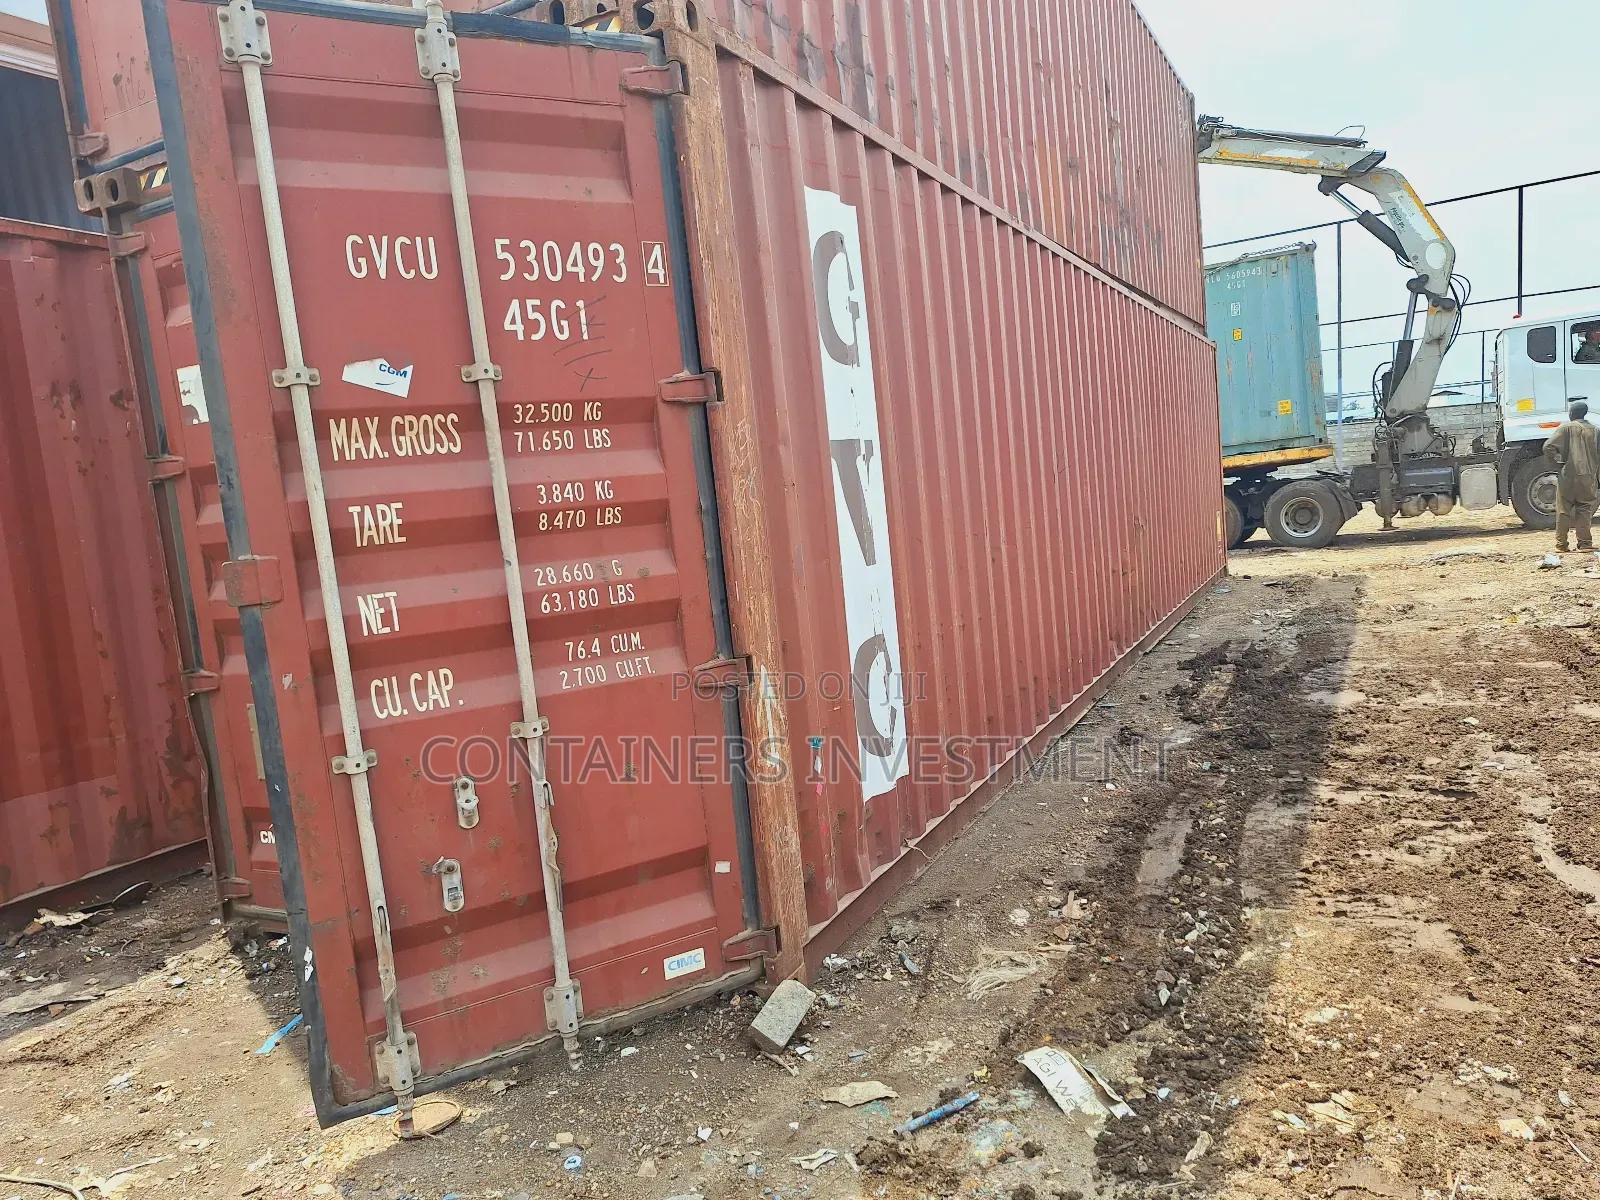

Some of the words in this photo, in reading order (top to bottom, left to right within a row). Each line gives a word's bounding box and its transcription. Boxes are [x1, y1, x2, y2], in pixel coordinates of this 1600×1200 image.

[346, 234, 439, 280] GVCU
[494, 238, 627, 283] 530493
[647, 244, 665, 284] 4
[502, 298, 589, 341] 45G1
[583, 401, 602, 421] KG
[329, 416, 390, 462] MAX.
[390, 412, 462, 457] GROSS
[584, 428, 612, 449] LBS
[594, 480, 614, 500] KG
[348, 502, 407, 548] TARE
[596, 506, 622, 526] LBS
[608, 583, 636, 605] LBS
[356, 591, 400, 637] NET
[564, 637, 601, 662] 76.4
[667, 953, 702, 971] CIMC
